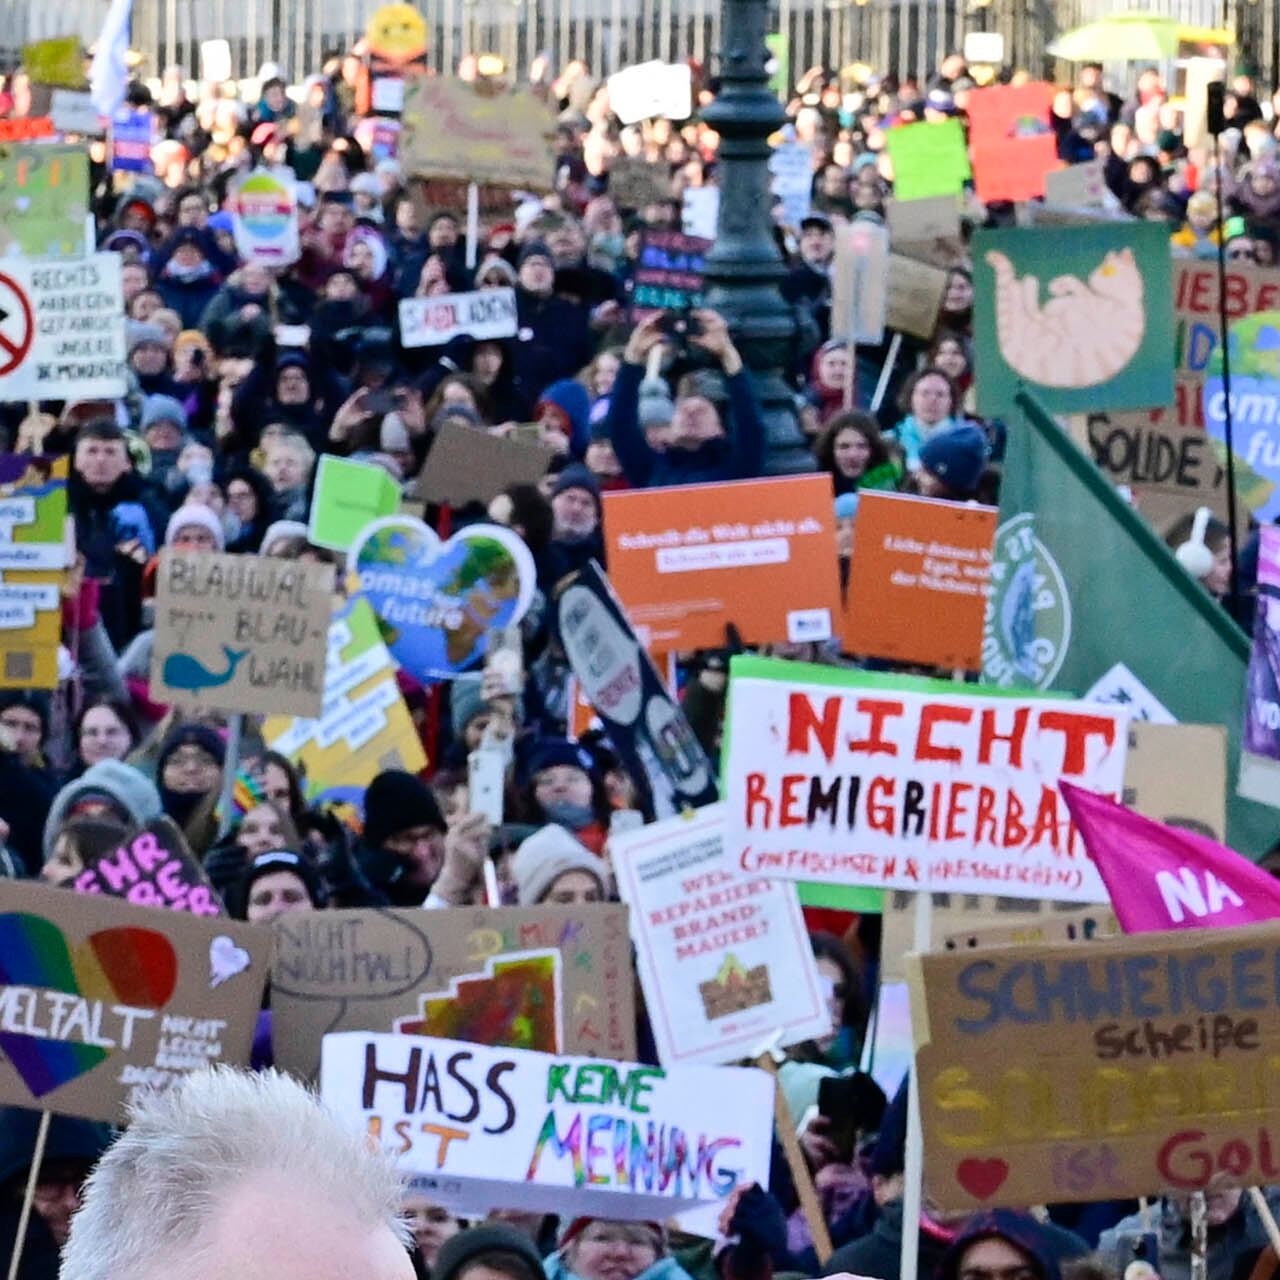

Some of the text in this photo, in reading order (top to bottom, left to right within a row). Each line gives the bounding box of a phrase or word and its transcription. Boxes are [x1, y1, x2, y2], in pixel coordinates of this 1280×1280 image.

[168, 558, 308, 603] BLAUWAL
[360, 569, 435, 599] omas
[382, 597, 466, 631] future
[247, 656, 318, 693] WAHL
[785, 692, 1117, 777] NICHT
[671, 903, 763, 942] BRAND-
[361, 1041, 518, 1136] HASS
[365, 1109, 746, 1199] IST MEINUNG
